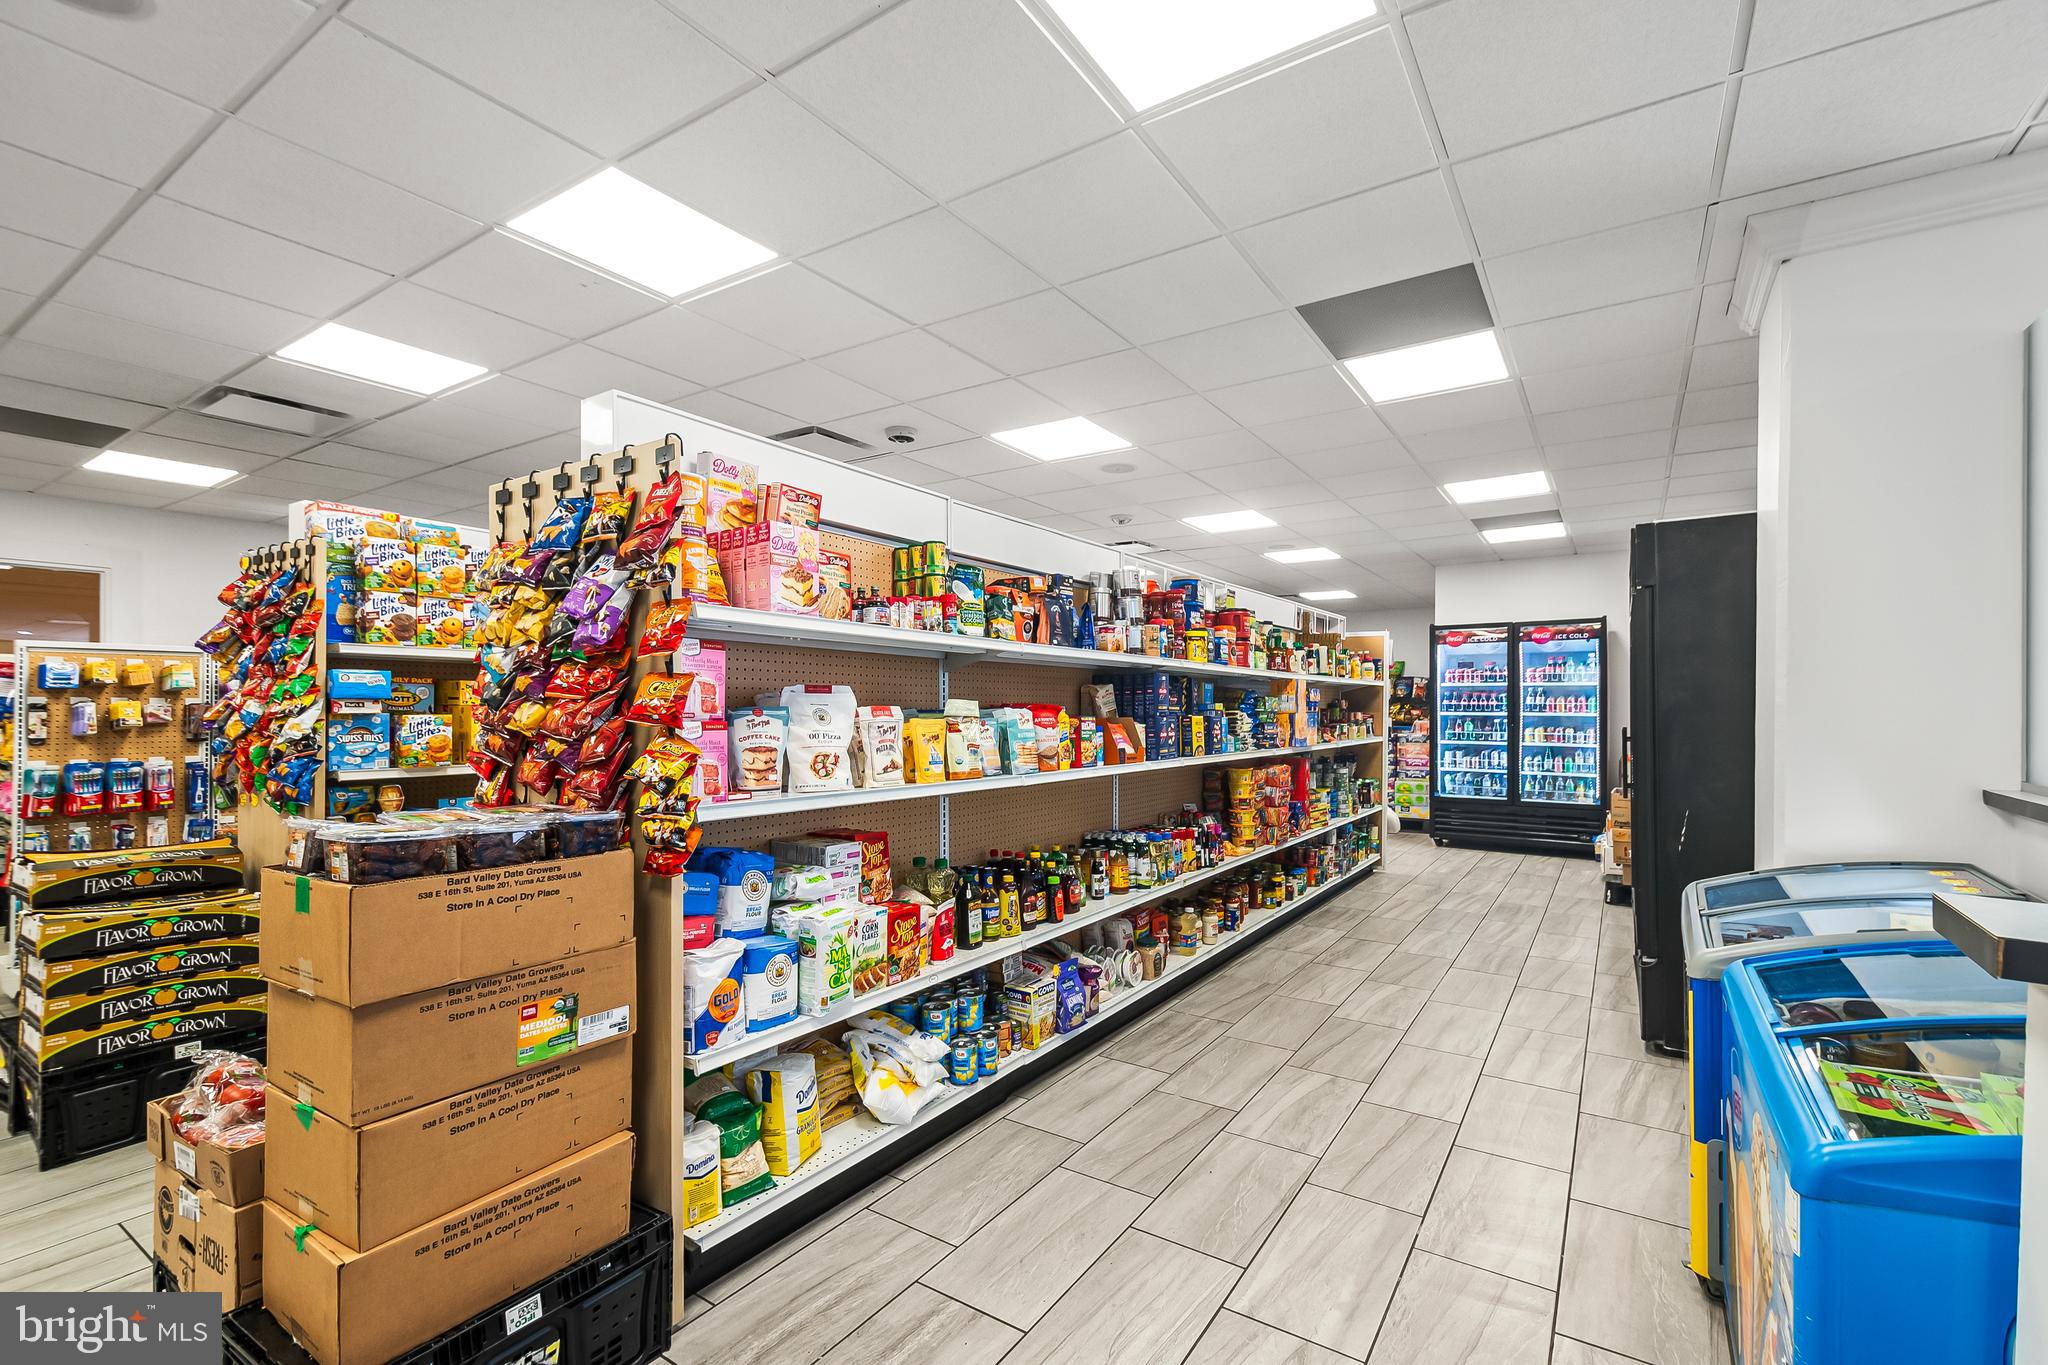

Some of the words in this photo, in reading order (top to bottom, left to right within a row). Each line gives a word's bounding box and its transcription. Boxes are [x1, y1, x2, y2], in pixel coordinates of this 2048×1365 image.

[713, 459, 739, 479] Dolly
[799, 494, 818, 506] Delights
[327, 517, 354, 530] Little
[336, 526, 364, 537] Bites
[372, 544, 396, 555] Little
[772, 536, 798, 555] Dolly
[380, 552, 404, 561] Bites
[425, 550, 447, 561] Little
[432, 559, 455, 568] Bites
[830, 558, 848, 567] Delights
[372, 596, 396, 609] Little
[381, 606, 405, 616] Bites
[424, 602, 446, 613] Little
[431, 610, 453, 620] Bites
[409, 718, 432, 733] Little
[417, 727, 440, 739] Bites
[738, 734, 763, 742] COFFEE
[765, 734, 781, 742] CAKE
[876, 746, 888, 754] PIZZA
[72, 856, 126, 867] FLAVOR
[152, 850, 206, 858] GROWN
[862, 840, 885, 865] Stove
[870, 853, 882, 868] Top
[84, 875, 132, 894] FLAVOR
[156, 868, 203, 882] GROWN
[447, 878, 470, 886] Bard
[473, 873, 501, 883] Valley
[504, 870, 524, 878] Date
[526, 866, 561, 875] Growers
[418, 892, 433, 900] 538
[444, 888, 460, 896] 16th
[514, 878, 534, 886] Yuma
[547, 873, 566, 881] 85364
[447, 902, 473, 912] Store
[496, 894, 517, 904] Cool
[520, 892, 535, 901] Dry
[537, 889, 560, 898] Place
[96, 925, 148, 947] FLAVOR
[174, 916, 224, 933] GROWN
[862, 922, 878, 934] CORN
[862, 931, 878, 942] FLAKES
[891, 916, 917, 943] Stove
[900, 929, 914, 946] Top
[856, 941, 880, 958] Crumbs
[104, 961, 155, 984] FLAVOR
[181, 948, 230, 966] GROWN
[448, 986, 472, 996] Bard
[475, 978, 503, 991] Valley
[506, 973, 526, 982] Date
[529, 964, 564, 978] Growers
[1038, 982, 1055, 995] GOYA
[420, 1004, 434, 1013] 538
[446, 996, 462, 1006] 16th
[478, 988, 497, 998] Suite
[517, 980, 536, 989] Yuma
[550, 971, 569, 980] 85364
[571, 967, 585, 975] USA
[714, 988, 738, 1006] GOLD
[772, 990, 787, 999] BREAD
[101, 995, 153, 1020] FLAVOR
[178, 981, 228, 1000] GROWN
[449, 1010, 475, 1022] Store
[499, 998, 520, 1008] Cool
[522, 993, 537, 1003] Dry
[540, 987, 563, 997] Place
[772, 996, 787, 1004] FLOUR
[98, 1030, 150, 1055] FLAVOR
[175, 1013, 225, 1032] GROWN
[449, 1096, 472, 1110] Bard
[475, 1087, 501, 1100] Valley
[504, 1079, 523, 1089] Date
[526, 1065, 560, 1081] Growers
[422, 1122, 436, 1130] 538
[447, 1110, 463, 1121] 16th
[478, 1098, 496, 1109] Suite
[515, 1085, 534, 1095] Yuma
[547, 1072, 565, 1083] 85364
[567, 1066, 581, 1075] USA
[450, 1122, 475, 1135] Store
[489, 1112, 496, 1120] A
[498, 1103, 518, 1116] Cool
[521, 1097, 536, 1108] Dry
[538, 1088, 560, 1101] Place
[686, 1154, 715, 1174] Domino
[444, 1219, 467, 1234] Bard
[470, 1205, 498, 1221] Valley
[501, 1196, 521, 1208] Date
[524, 1178, 560, 1196] Growers
[415, 1248, 430, 1257] 538
[441, 1234, 458, 1245] 16th
[473, 1219, 493, 1230] Suite
[512, 1201, 532, 1211] Yuma
[534, 1194, 544, 1202] AZ
[546, 1184, 566, 1198] 85364
[567, 1176, 581, 1186] USA
[444, 1244, 471, 1259] Store
[474, 1238, 482, 1246] In
[485, 1232, 492, 1240] A
[495, 1223, 516, 1235] Cool
[519, 1214, 534, 1225] Dry
[536, 1202, 560, 1216] Place
[203, 1234, 224, 1275] FRESH
[514, 1312, 538, 1328] IFCO
